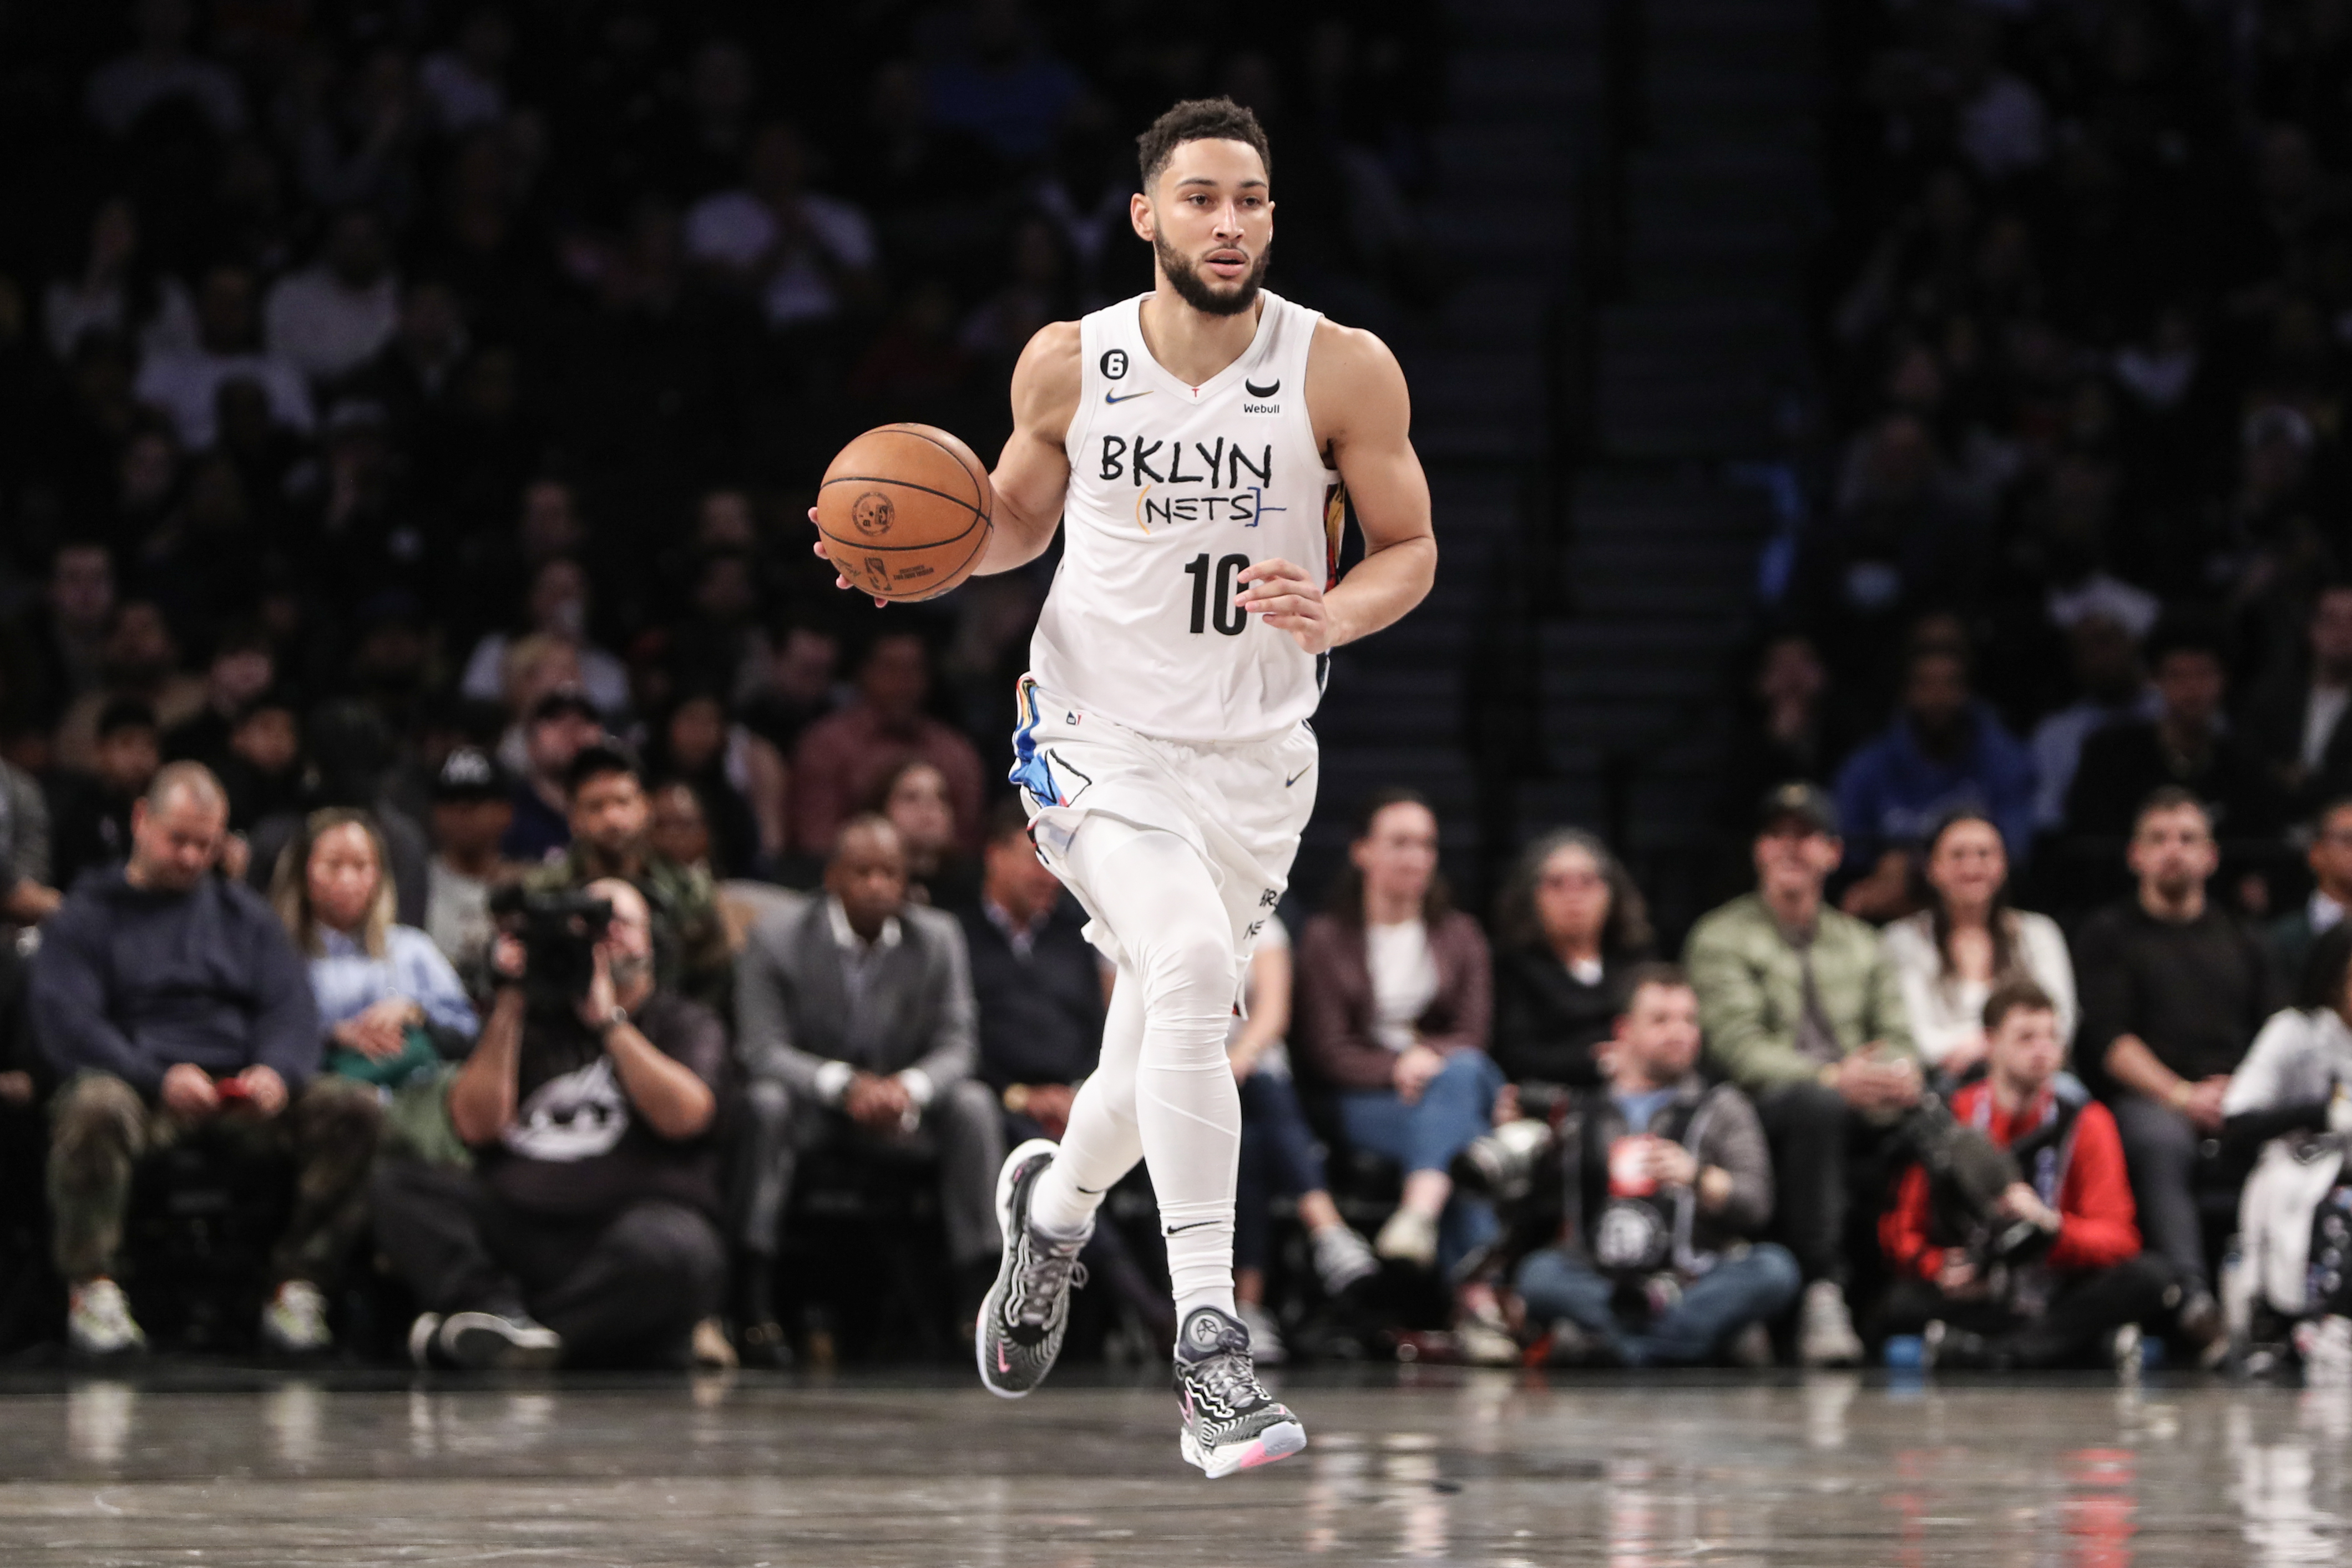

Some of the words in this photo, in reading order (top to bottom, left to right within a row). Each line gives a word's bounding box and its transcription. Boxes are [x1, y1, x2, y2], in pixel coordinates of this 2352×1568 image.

[1107, 353, 1124, 376] 6
[1244, 403, 1279, 413] Webull
[1100, 436, 1271, 488] BKLYN
[1185, 553, 1250, 635] 10
